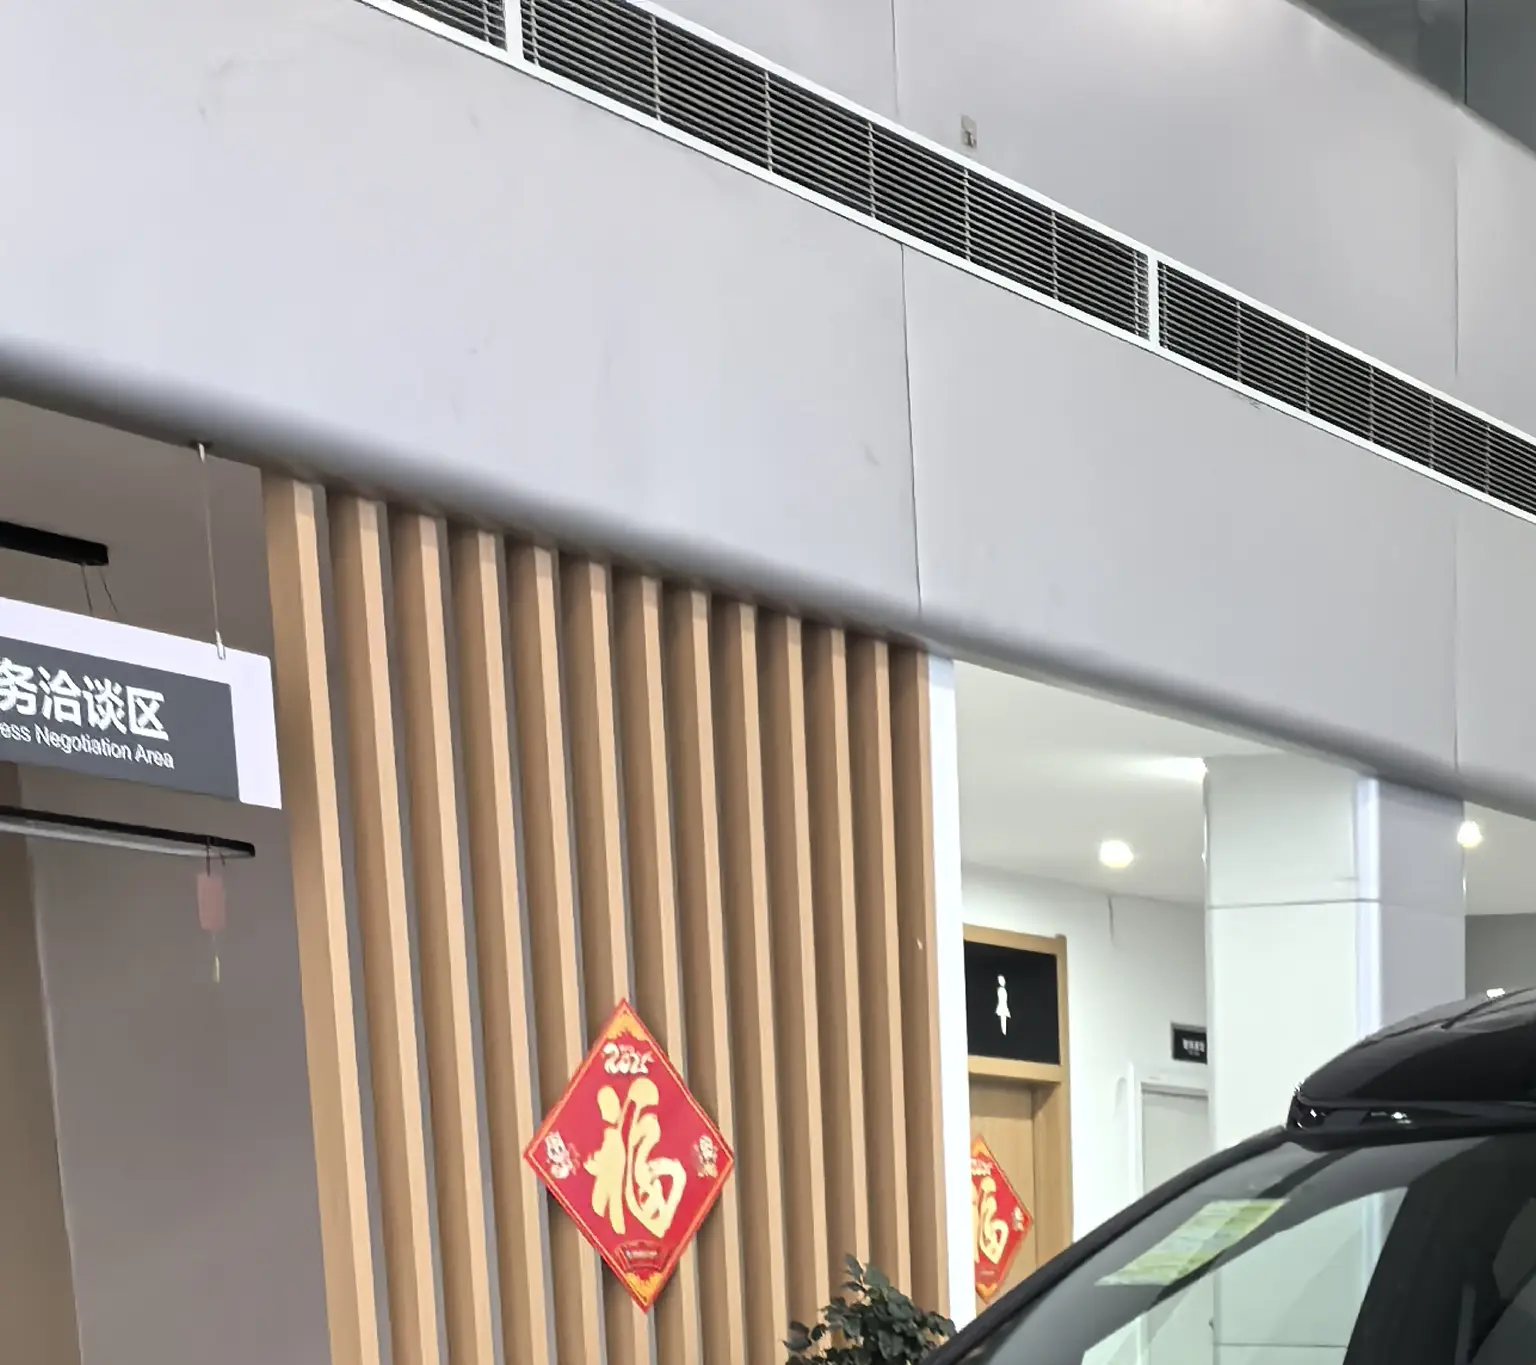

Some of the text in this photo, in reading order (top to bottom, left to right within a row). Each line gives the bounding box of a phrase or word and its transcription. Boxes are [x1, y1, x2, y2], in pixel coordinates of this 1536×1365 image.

[0, 657, 170, 742] 务洽谈区
[34, 723, 134, 762] Negotiation
[134, 744, 175, 770] Area
[583, 1077, 687, 1239] 福
